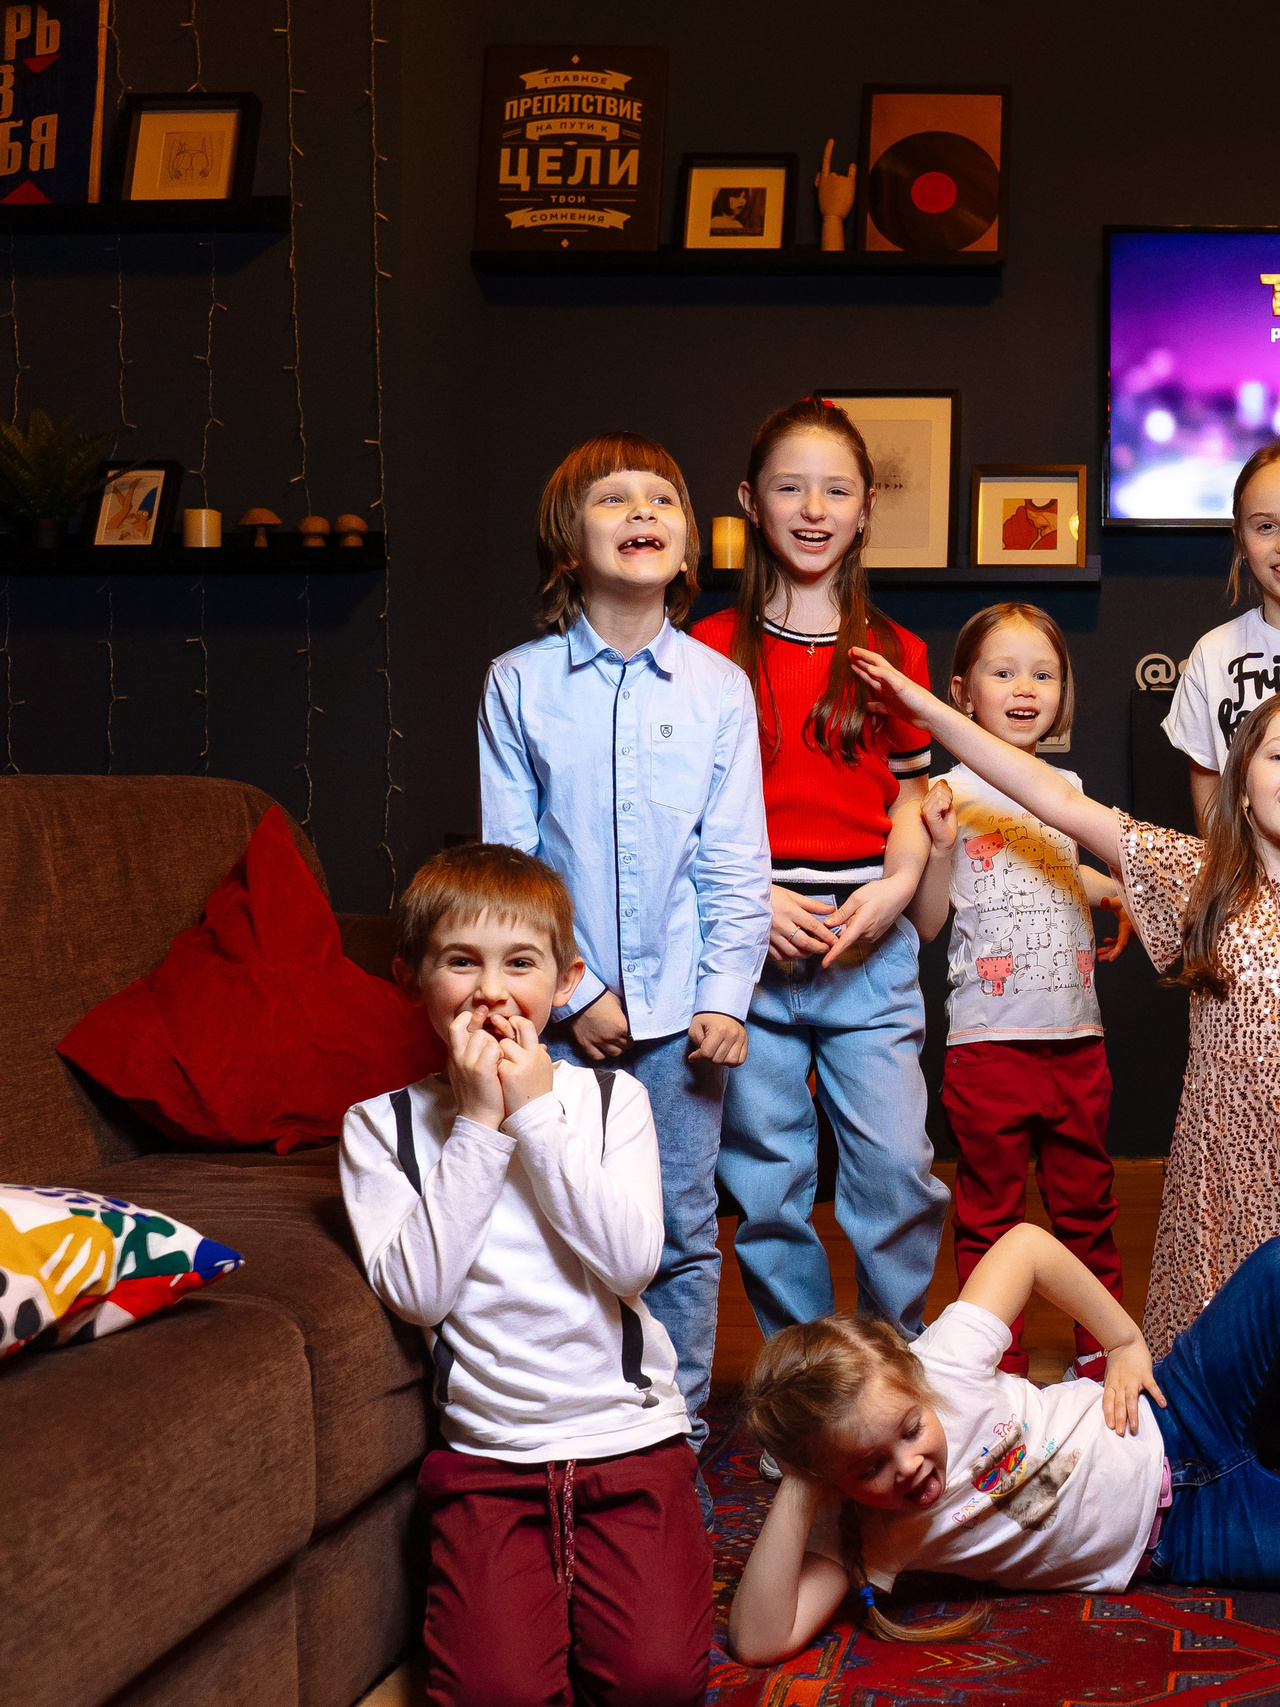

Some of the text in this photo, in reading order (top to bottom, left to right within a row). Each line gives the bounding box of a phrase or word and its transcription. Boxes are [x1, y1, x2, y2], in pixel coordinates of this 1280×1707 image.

[544, 75, 609, 86] ГЛАВНОЕ
[504, 93, 643, 122] ПРЕПЯТСТВИЕ
[536, 121, 609, 133] НА ПУТИ К
[499, 148, 639, 192] ЦЕЛИ
[550, 194, 586, 204] ТВОИ
[530, 212, 606, 224] СОМНЕНИЯ
